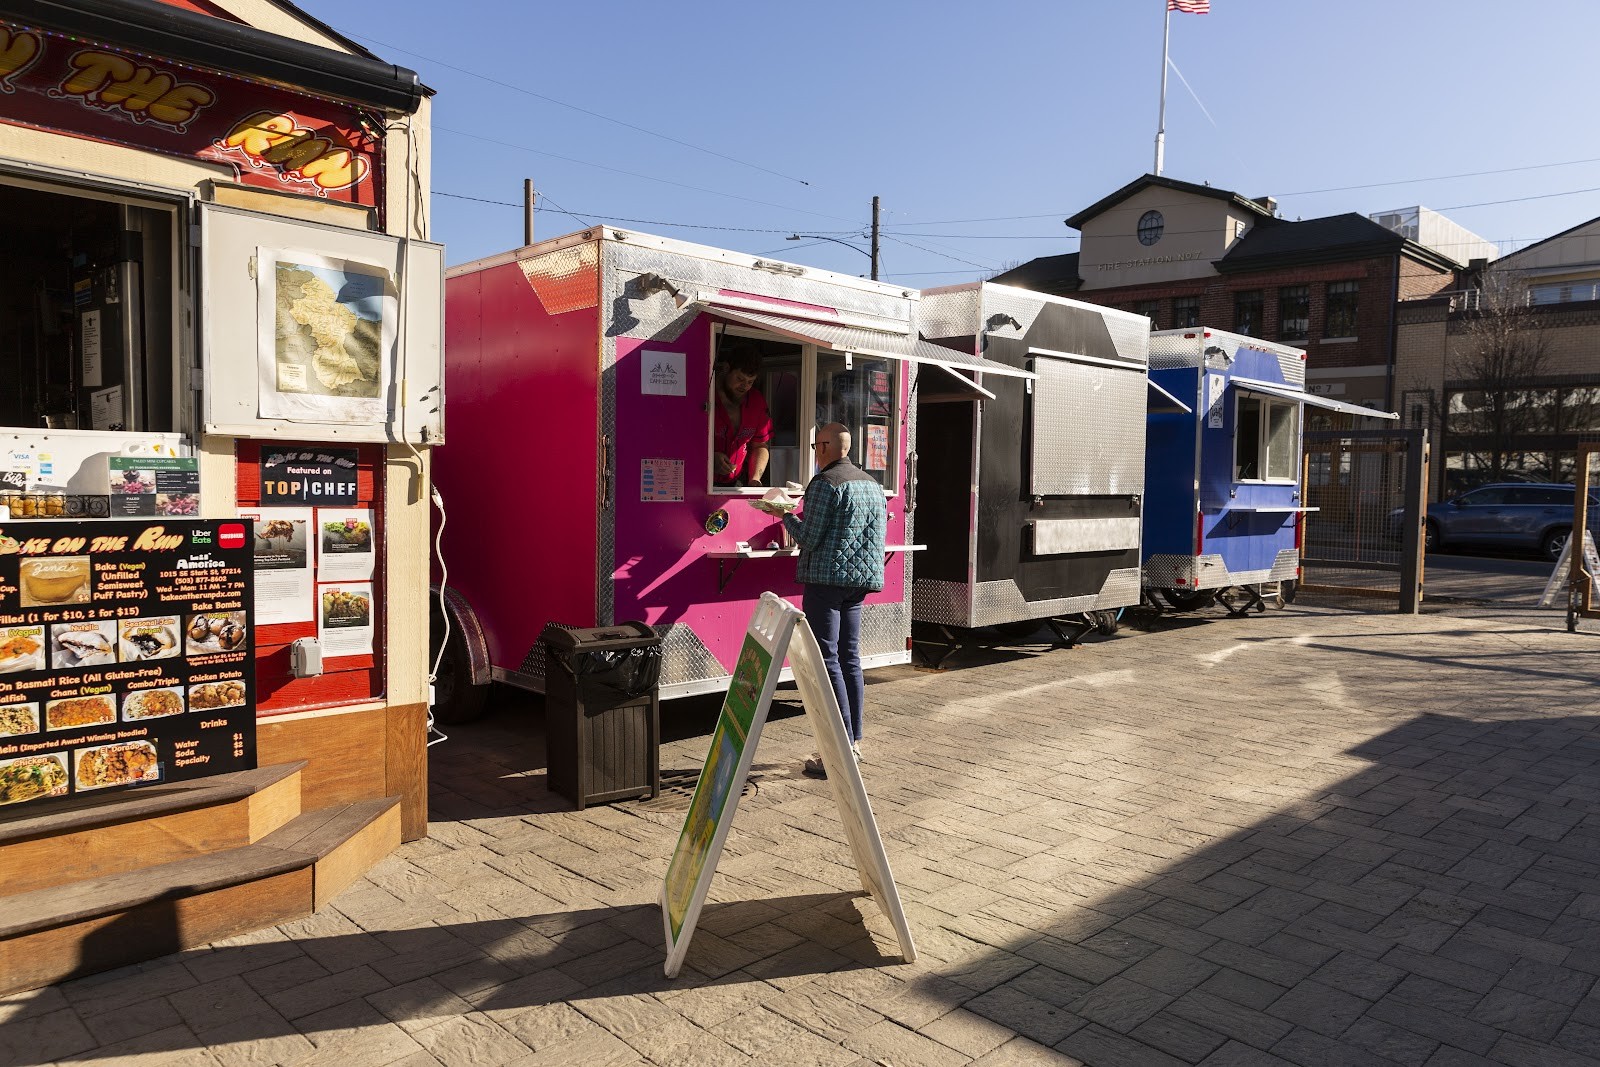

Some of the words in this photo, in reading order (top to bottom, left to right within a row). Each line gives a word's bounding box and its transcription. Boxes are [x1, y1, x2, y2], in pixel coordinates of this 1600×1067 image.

[56, 50, 216, 130] THE
[218, 110, 370, 194] RUN
[1098, 262, 1120, 272] FIRE
[1126, 256, 1172, 268] STATION
[1326, 384, 1332, 393] 7
[299, 452, 314, 460] ON
[316, 454, 334, 462] THE
[287, 466, 320, 474] Featured
[264, 480, 301, 496] TOP
[312, 482, 356, 496] CHEF
[52, 536, 86, 554] ON
[88, 536, 129, 554] THE
[94, 563, 117, 571] Bake
[119, 562, 146, 571] (Vegan)
[176, 558, 226, 570] America
[102, 572, 140, 581] (Unfilled
[175, 577, 194, 586] (503)
[98, 581, 144, 590] Semisweet
[78, 594, 90, 602] $4
[94, 592, 114, 600] Puff
[116, 589, 148, 598] Pastry)
[160, 590, 242, 602] bakeontherunpdx.com
[192, 602, 212, 610] Bake
[216, 600, 242, 610] Bombs
[28, 613, 40, 624] (1
[43, 612, 60, 622] for
[62, 610, 85, 620] $10,
[88, 610, 96, 618] 2
[99, 608, 114, 618] for
[117, 606, 140, 617] $15)
[70, 624, 99, 632] Nutella
[124, 620, 158, 628] Seasonal
[8, 626, 42, 638] (Vegan)
[137, 627, 163, 635] (Vegan)
[0, 684, 12, 692] On
[16, 678, 56, 690] Basmati
[59, 676, 80, 686] Rice
[83, 674, 102, 684] (All
[105, 666, 163, 681] Gluten-Free)
[189, 674, 218, 683] Chicken
[220, 670, 242, 680] Potato
[128, 677, 180, 690] Combo/Triple
[50, 689, 78, 698] Chana
[80, 684, 112, 696] (Vegan)
[100, 716, 116, 724] $13
[200, 718, 228, 729] Drinks
[20, 724, 38, 734] $13
[20, 740, 60, 752] (Imported
[60, 736, 86, 746] Award
[86, 732, 116, 742] Winning
[118, 728, 148, 739] Noodles)
[174, 740, 200, 750] Water
[233, 732, 243, 741] $1
[112, 743, 140, 752] Dorado
[175, 749, 194, 758] Soda
[234, 742, 244, 750] $2
[14, 756, 48, 768] Chicken
[175, 756, 210, 768] Specialty
[234, 750, 244, 758] $3
[51, 786, 68, 796] $19
